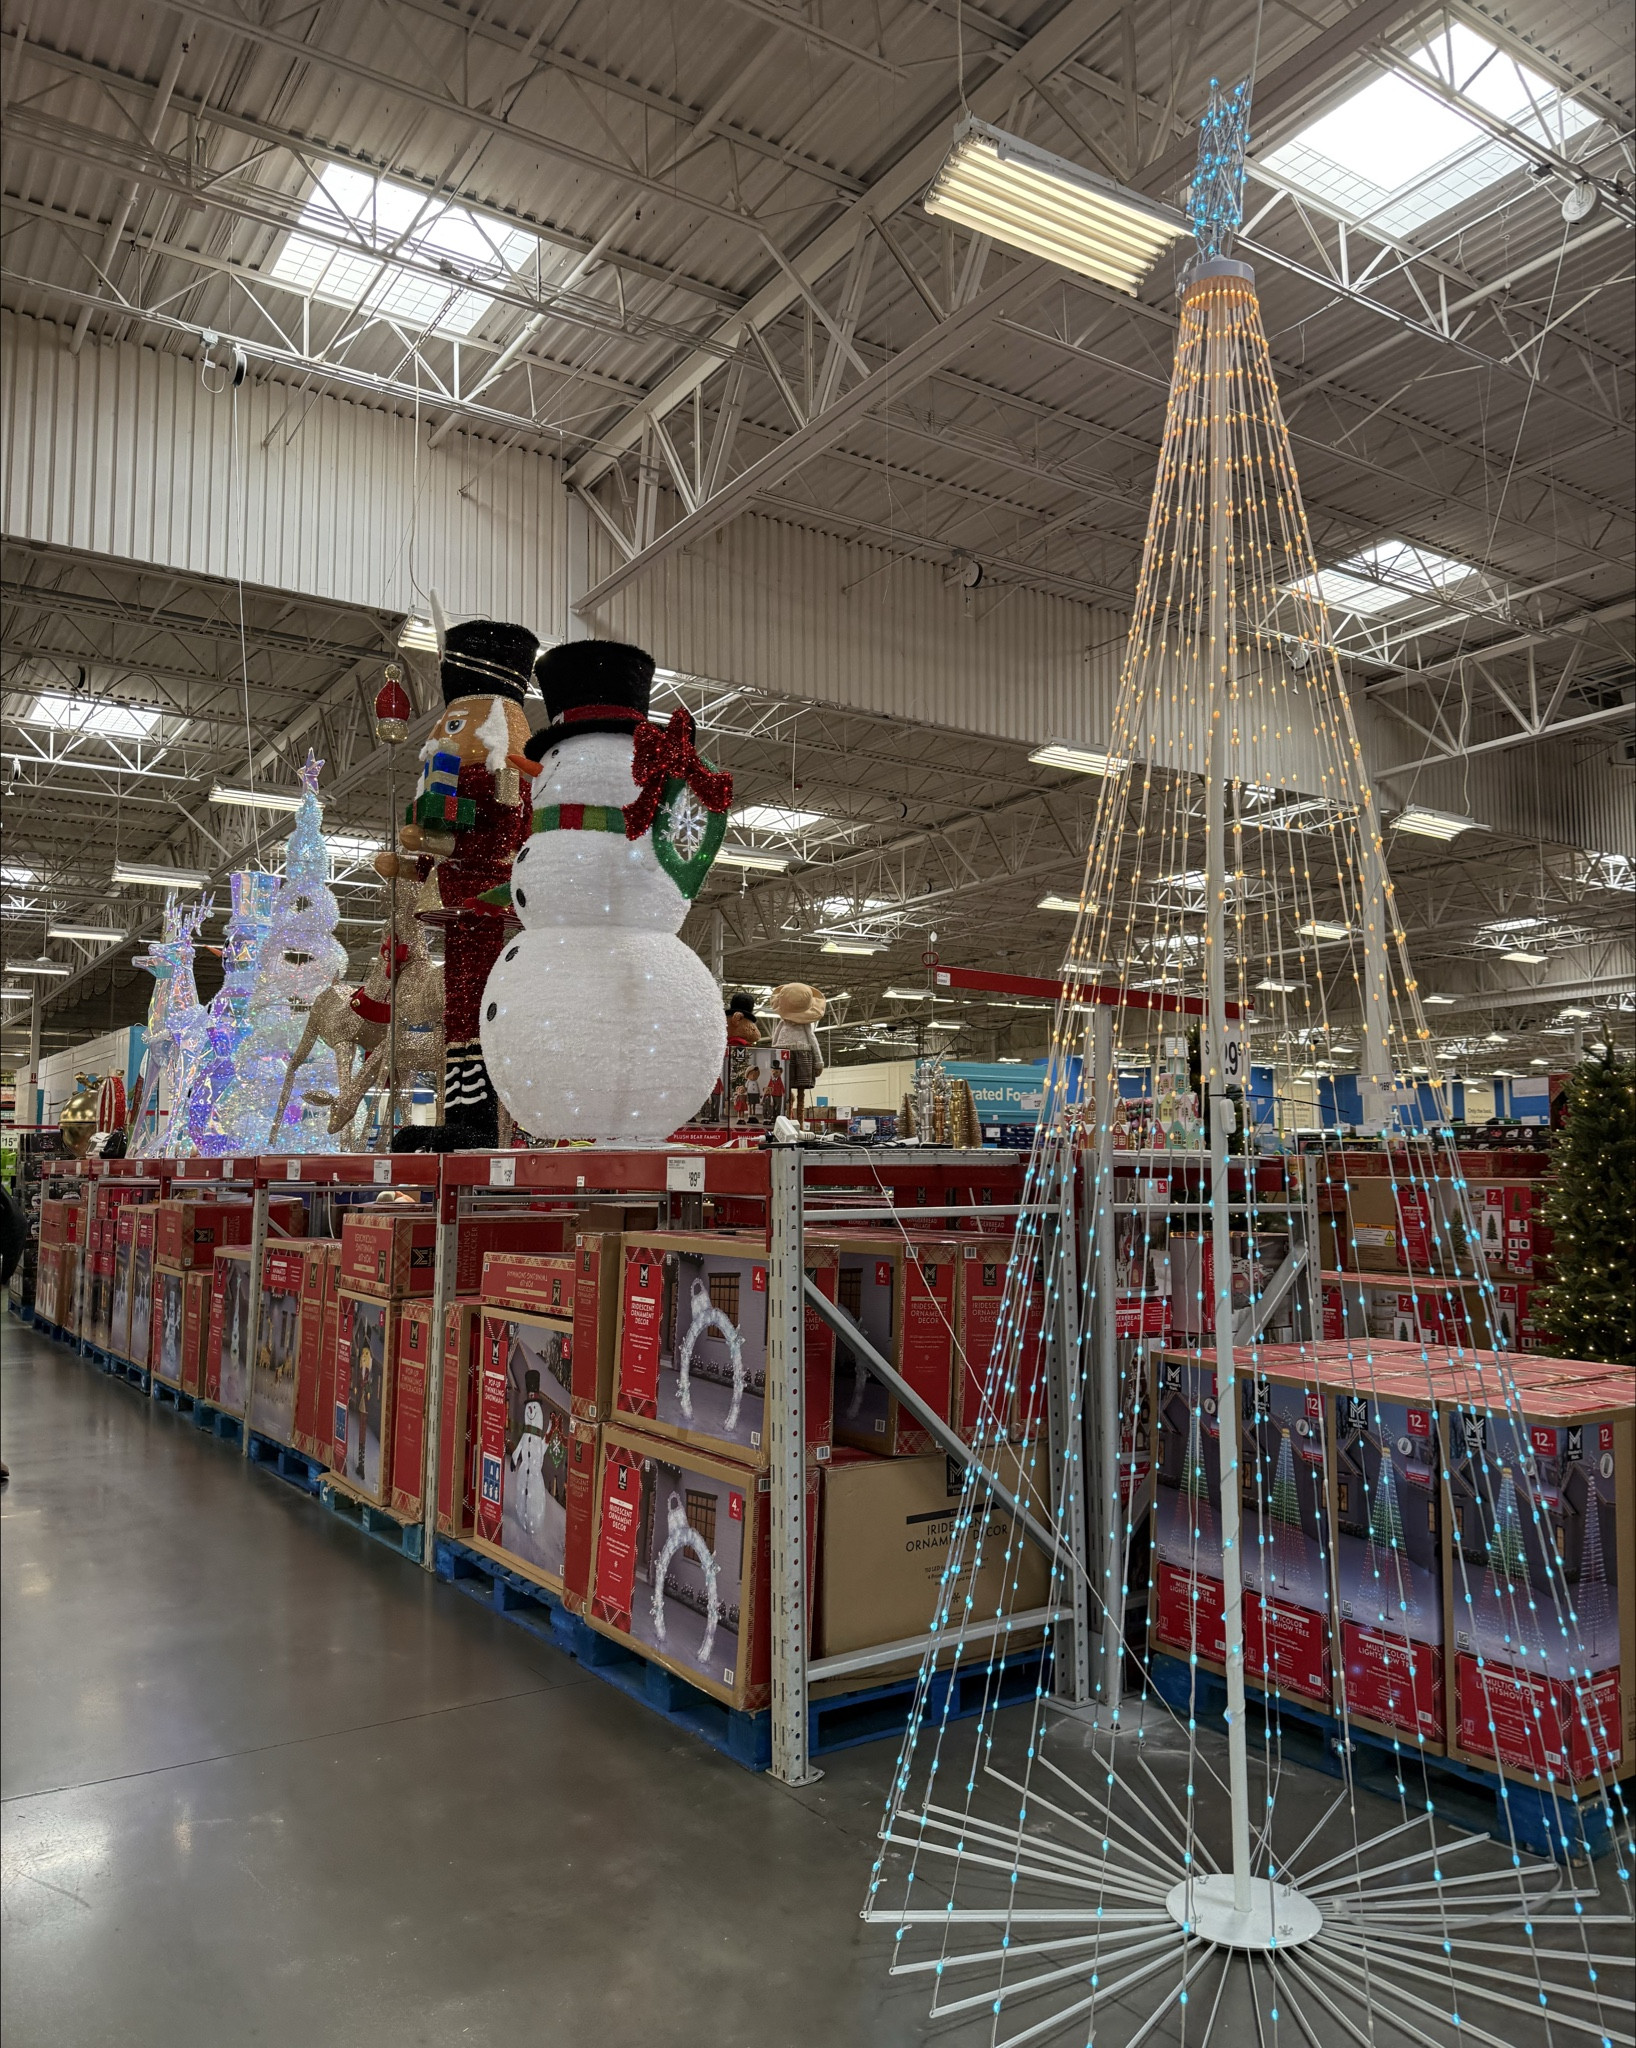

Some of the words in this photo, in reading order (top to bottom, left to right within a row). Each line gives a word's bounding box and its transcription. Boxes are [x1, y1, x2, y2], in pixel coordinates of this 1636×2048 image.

[971, 1087, 1003, 1101] rated
[1490, 1191, 1496, 1201] 7
[462, 1230, 471, 1282] TWINKLING
[469, 1226, 479, 1286] NUTCRACKER
[755, 1271, 761, 1284] 4
[878, 1266, 884, 1277] 4
[631, 1303, 655, 1312] IRIDESCENT
[631, 1310, 654, 1319] ORNAMENT
[635, 1317, 649, 1326] DECOR
[488, 1378, 501, 1388] POP-UP
[485, 1385, 505, 1398] TWINKLING
[484, 1392, 504, 1405] SNOWMAN
[1307, 1397, 1320, 1410] 12
[1409, 1414, 1422, 1428] 12
[1534, 1432, 1548, 1446] 12
[1600, 1429, 1609, 1442] 12
[732, 1498, 737, 1511] 4
[609, 1504, 633, 1519] IRIDESCENT
[608, 1511, 633, 1527] ORNAMENT
[612, 1521, 627, 1532] DECOR
[927, 1516, 984, 1536] IRIDEEN
[973, 1524, 1008, 1540] DCOR
[1203, 1596, 1216, 1606] TREE
[1258, 1615, 1294, 1631] LHTSHOW
[1295, 1628, 1310, 1638] TREE
[1358, 1647, 1400, 1665] LIGHTSOW
[1366, 1643, 1409, 1660] MULTCOLO
[1486, 1678, 1536, 1697] MULTICOLO
[1476, 1681, 1523, 1701] LIHTSHOW
[1525, 1696, 1545, 1709] TEE
